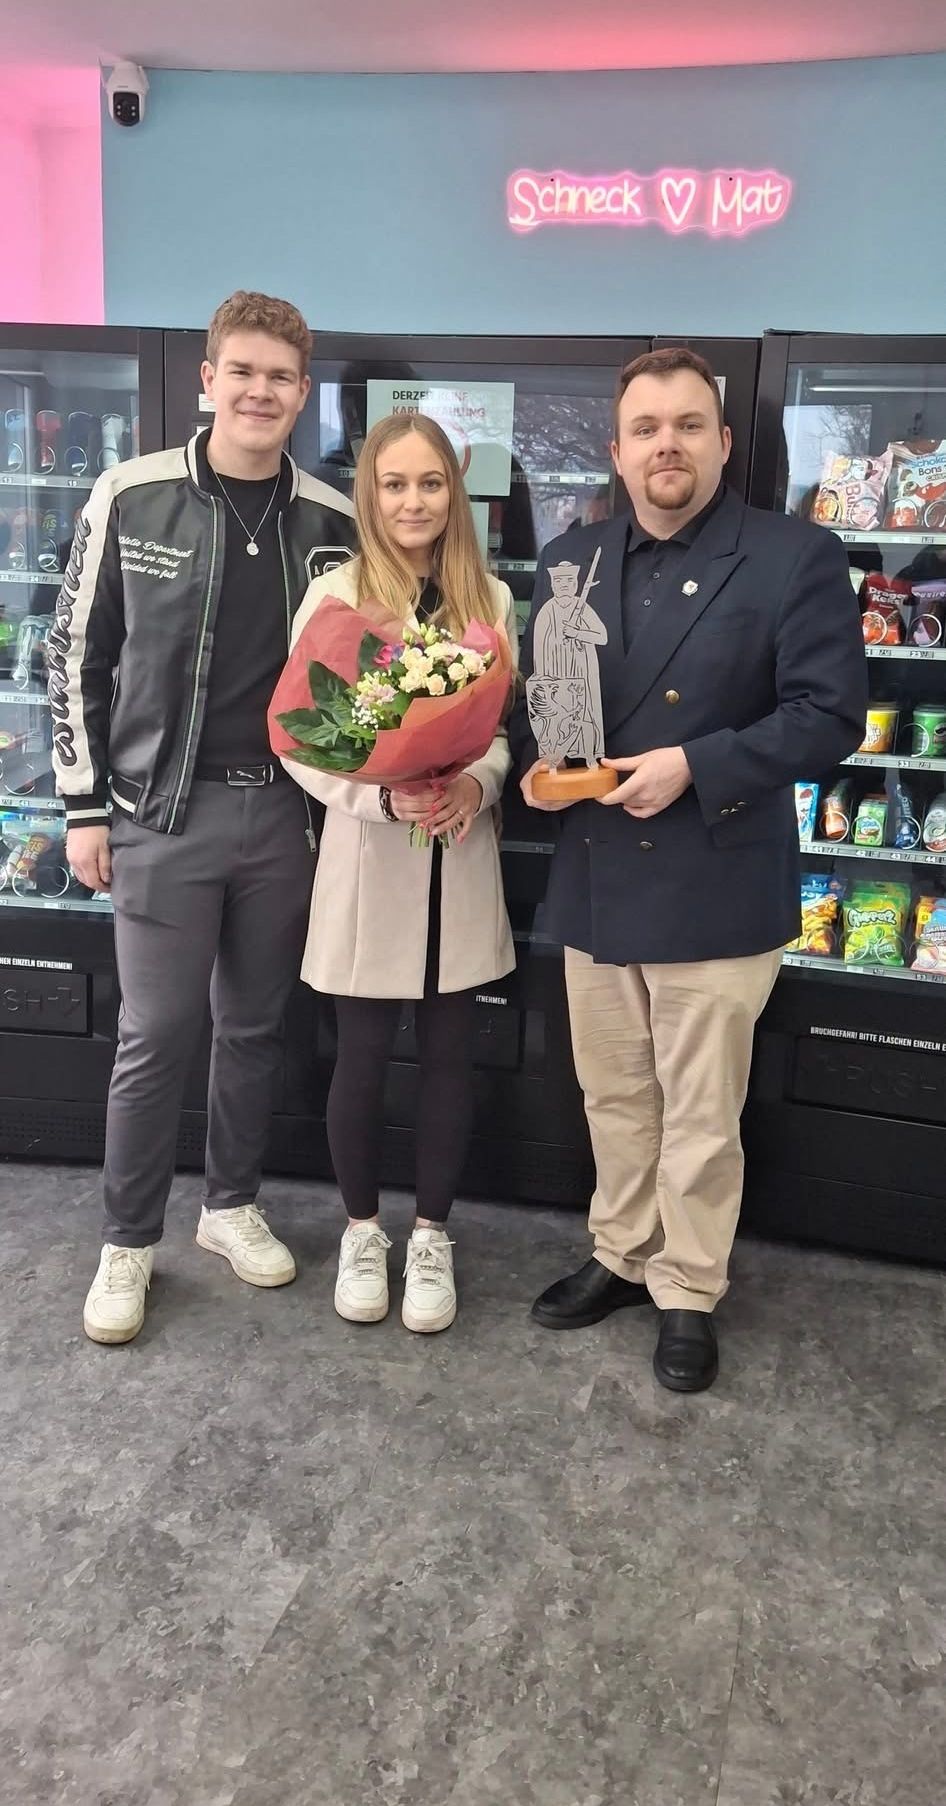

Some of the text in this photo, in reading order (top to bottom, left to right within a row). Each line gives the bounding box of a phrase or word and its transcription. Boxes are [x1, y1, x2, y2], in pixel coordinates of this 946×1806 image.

[508, 176, 784, 227] Schneck Mat
[12, 958, 35, 967] EINZELN
[36, 960, 72, 970] ENTNEHMEN!
[810, 1026, 858, 1039] BRUCHGEFAHR!
[858, 1032, 877, 1042] BITTE
[878, 1035, 911, 1047] FLASCHEN
[913, 1039, 940, 1051] EINZELN
